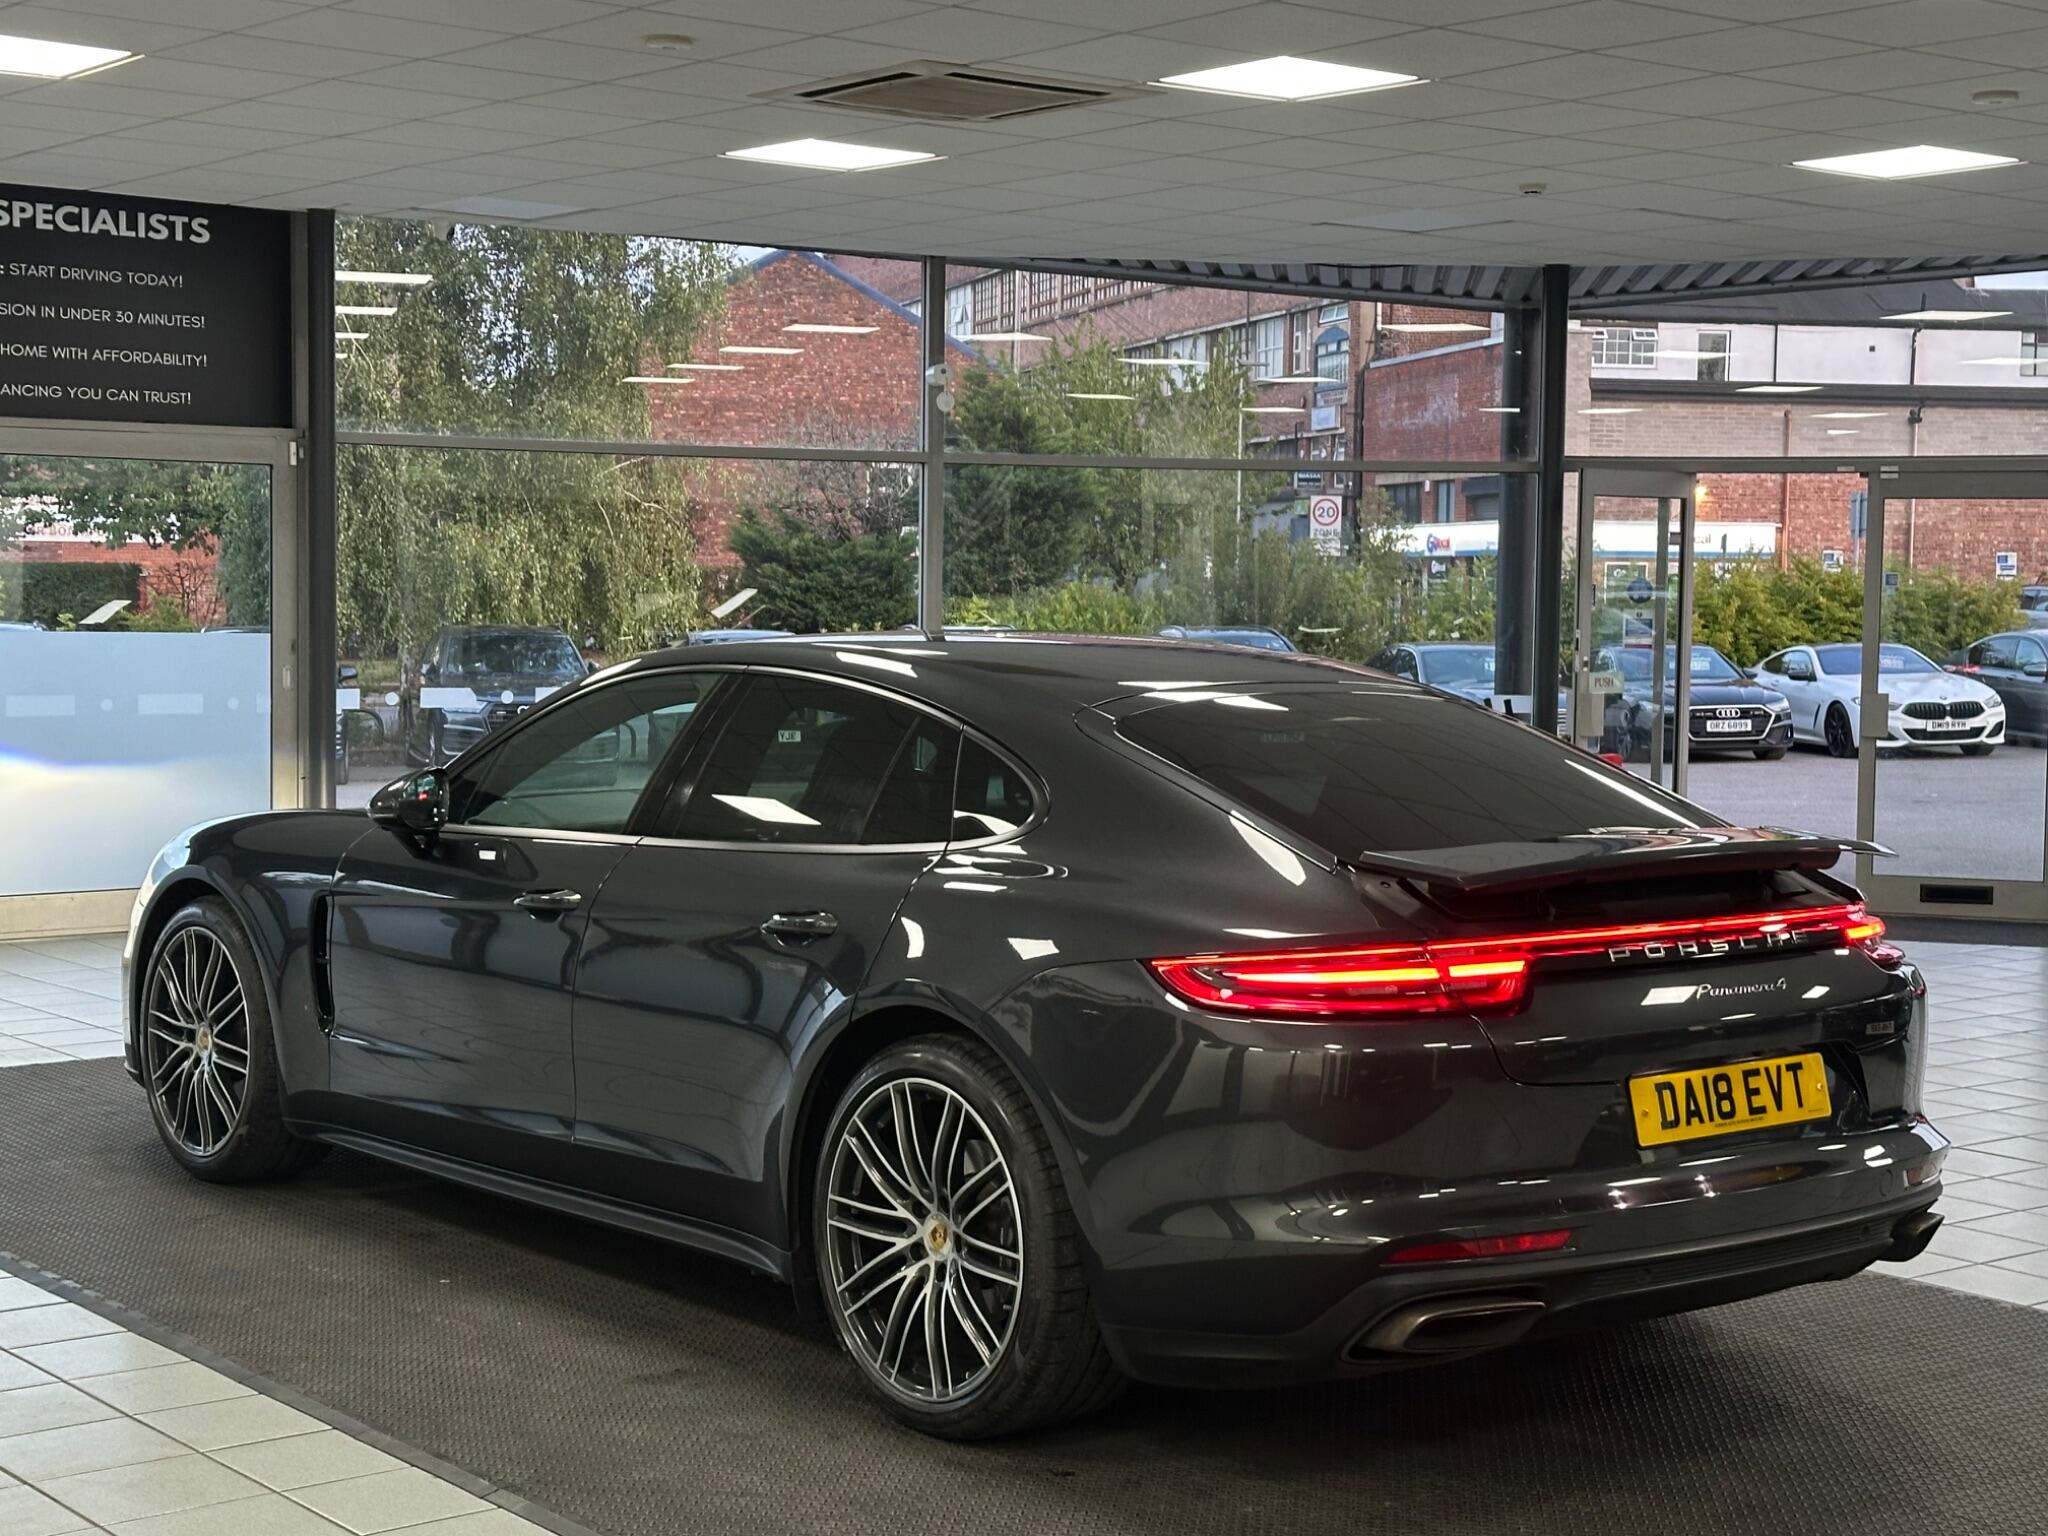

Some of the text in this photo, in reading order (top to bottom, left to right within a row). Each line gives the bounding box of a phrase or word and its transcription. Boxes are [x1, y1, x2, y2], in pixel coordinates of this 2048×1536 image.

[0, 199, 210, 243] SPECIALISTS
[9, 263, 55, 278] START
[60, 266, 122, 283] DRIVING
[127, 272, 183, 288] TODAY!
[41, 305, 55, 318] IN
[60, 307, 111, 322] UNDER
[115, 311, 133, 324] 30
[137, 313, 205, 328] MINUTES!
[0, 343, 207, 367] HOME WITH AFFORDABILITY!
[0, 383, 191, 405] ANCING YOU CAN TRUST!
[1317, 506, 1336, 518] 20
[1654, 1062, 1804, 1131] DA18 EVT
